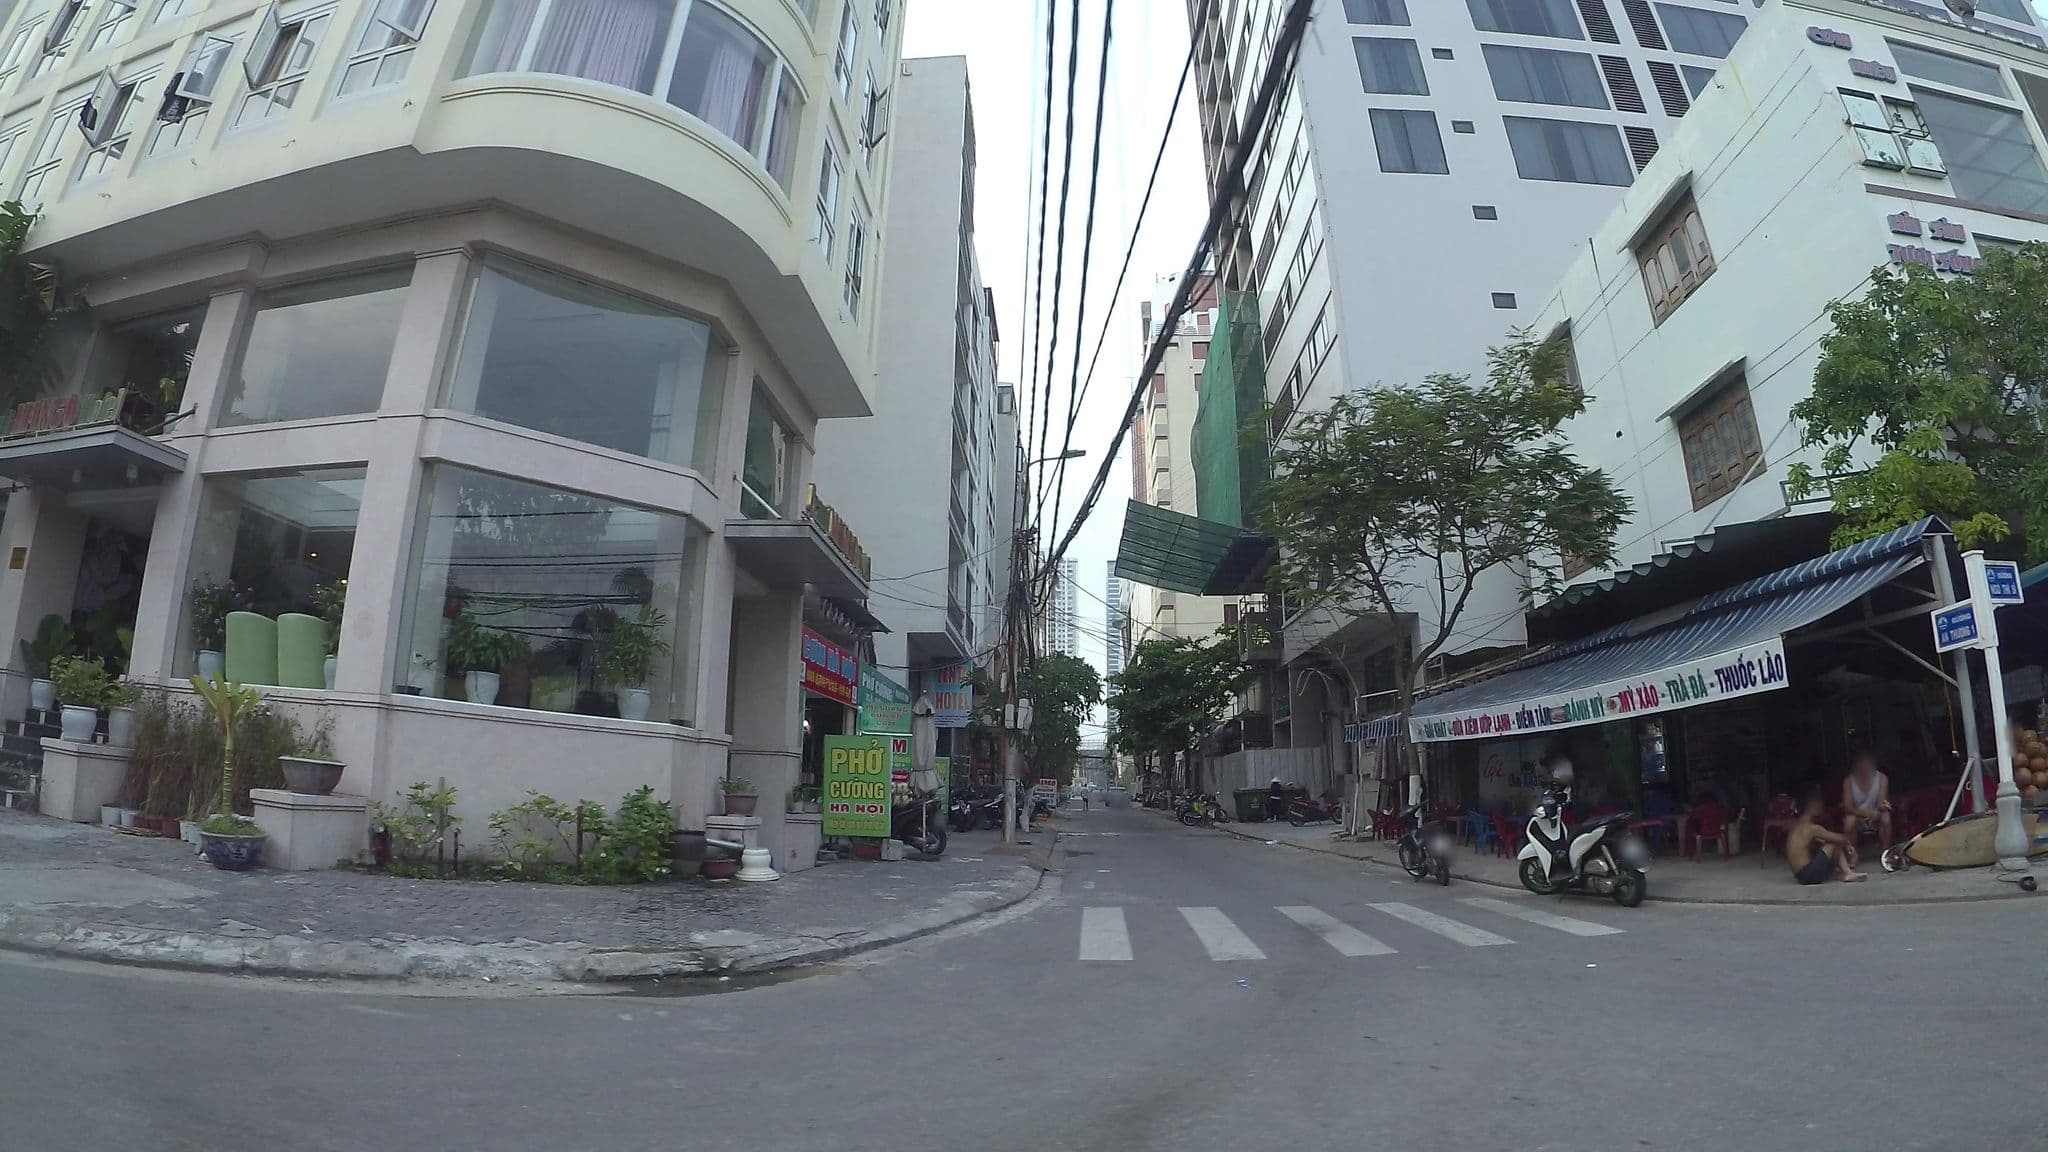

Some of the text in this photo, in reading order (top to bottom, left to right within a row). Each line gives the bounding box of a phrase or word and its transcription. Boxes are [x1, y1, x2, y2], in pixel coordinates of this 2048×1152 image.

[1636, 682, 1660, 710] XÀO
[1665, 673, 1689, 704] TRÀ
[1688, 668, 1709, 700] ĐÁ
[1714, 653, 1757, 694] THUỐC
[1757, 651, 1784, 685] LÀO
[936, 692, 968, 709] HOTEL
[831, 739, 885, 775] PHỞ
[830, 777, 885, 799] CƯỜNG
[829, 801, 884, 816] HÀ NỘI
